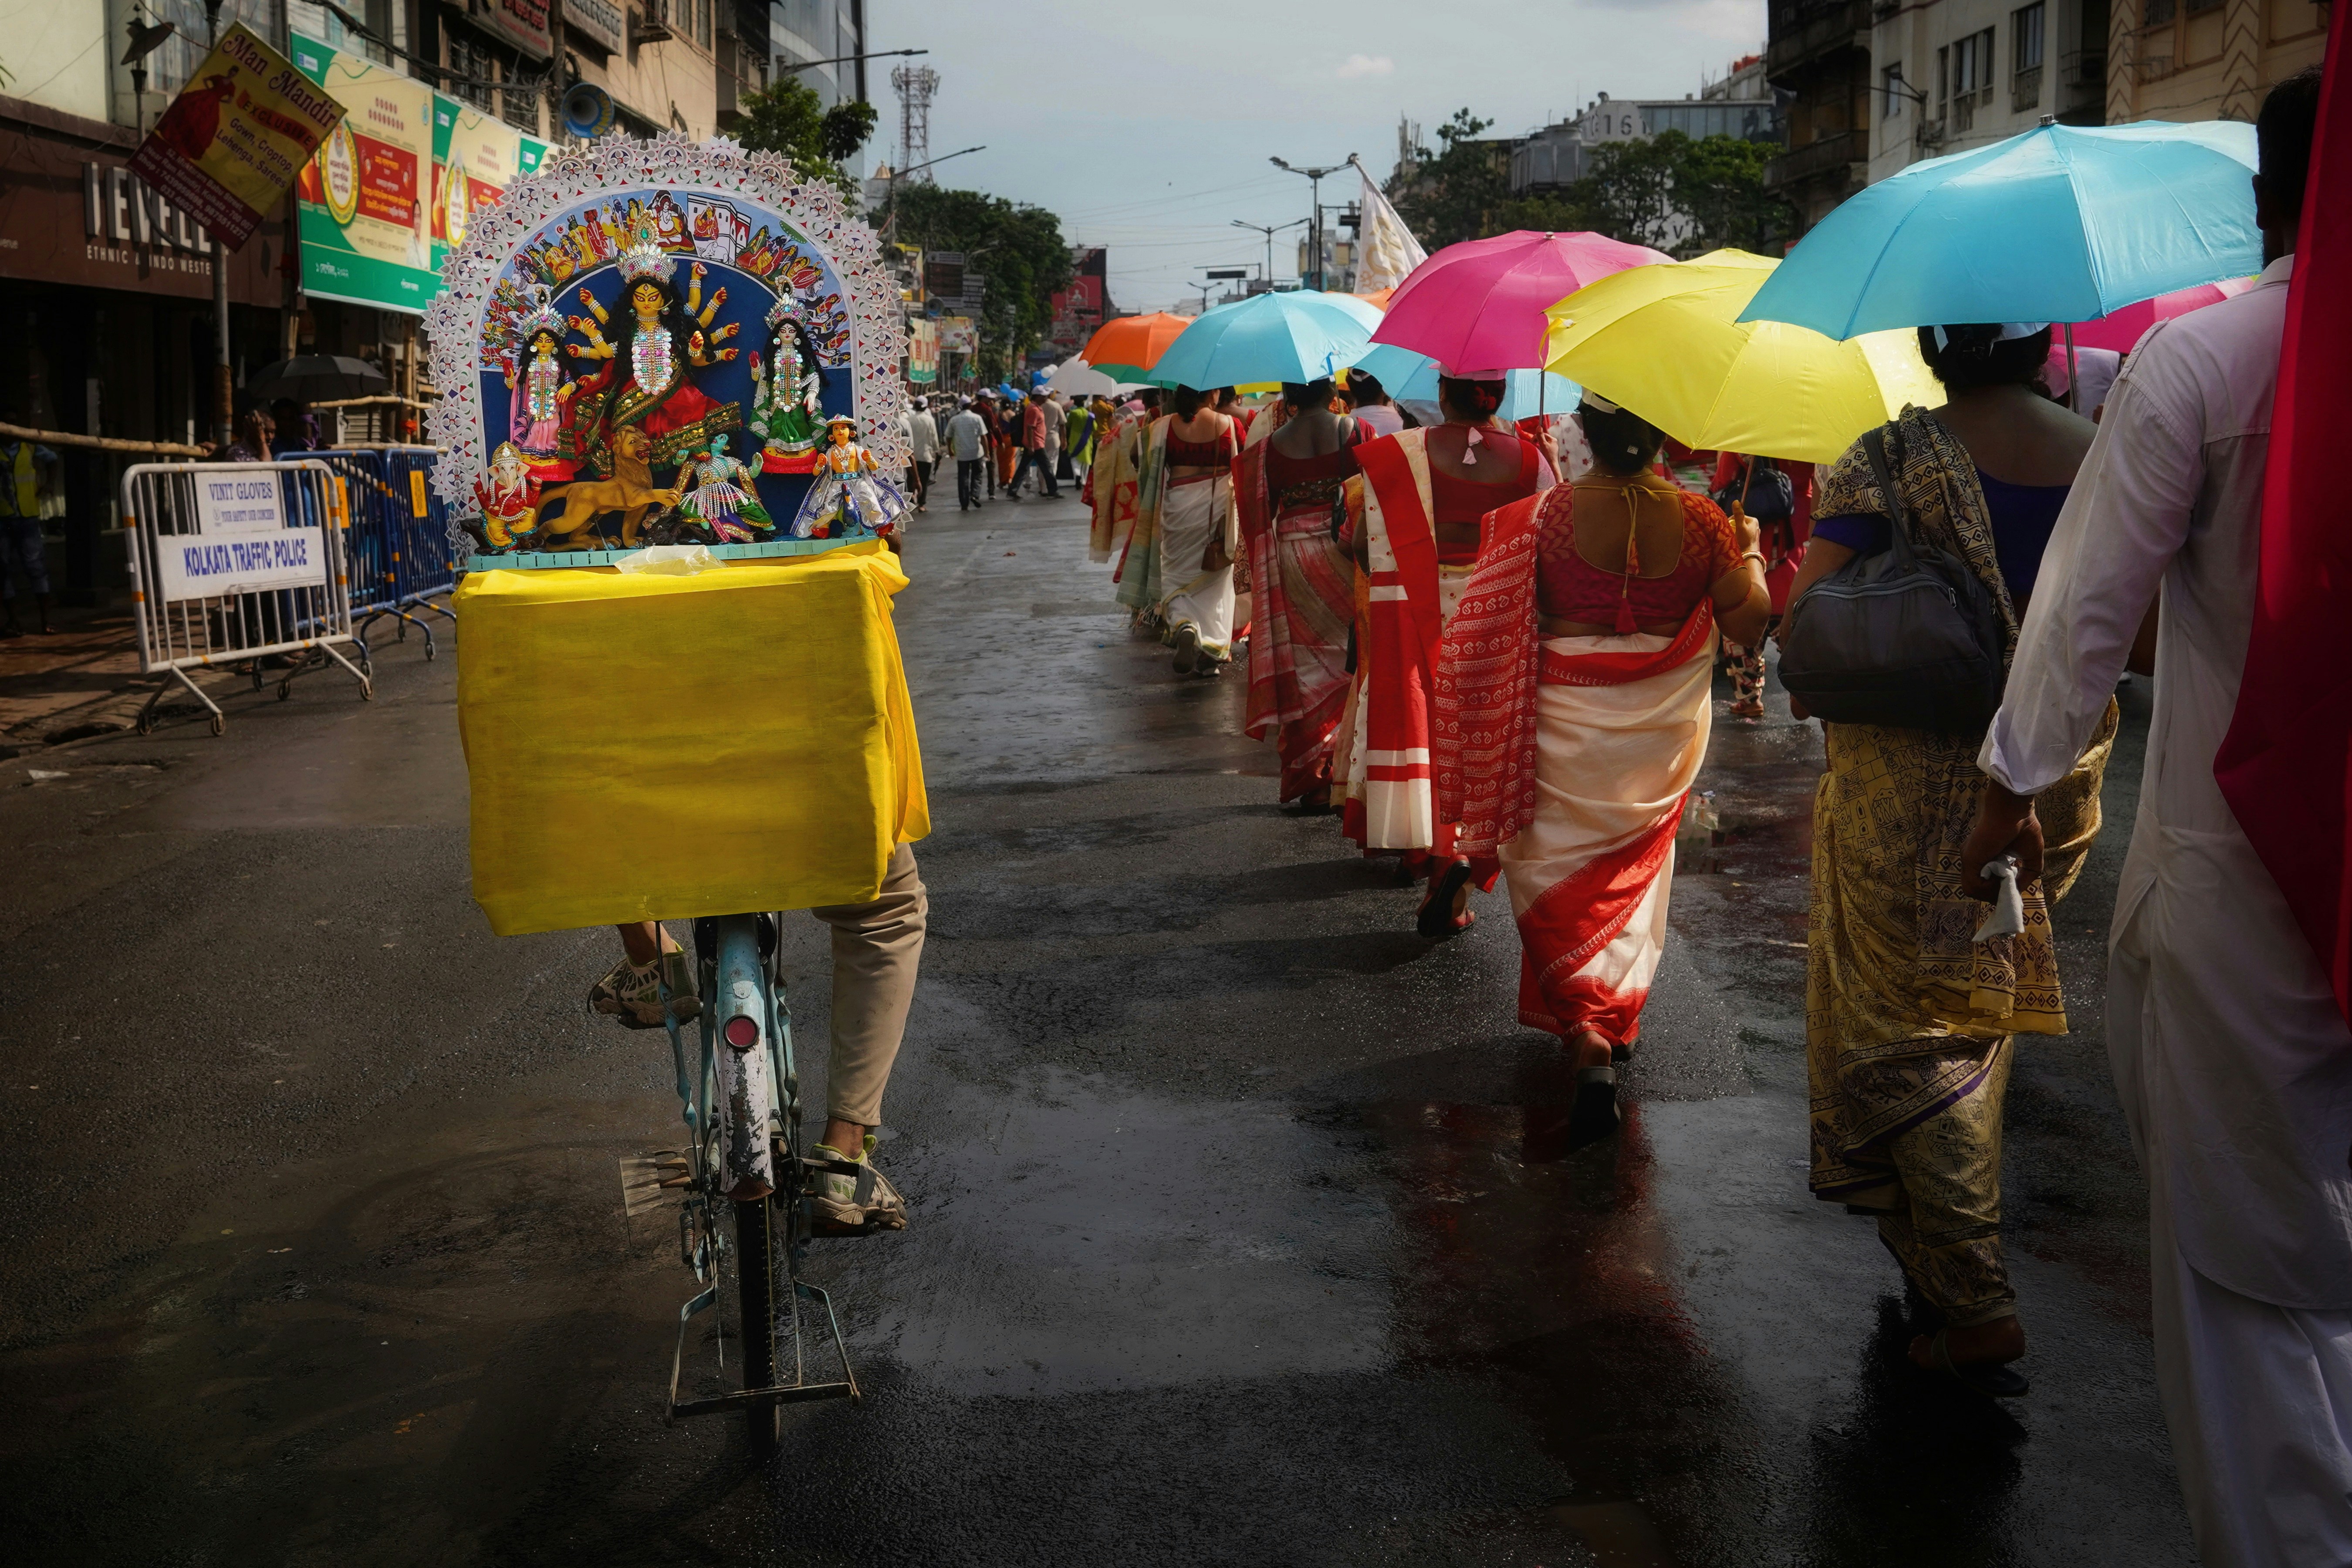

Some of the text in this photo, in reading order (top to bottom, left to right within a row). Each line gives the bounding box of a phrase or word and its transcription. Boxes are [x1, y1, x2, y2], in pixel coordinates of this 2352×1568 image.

[221, 34, 337, 128] Man Mandir
[242, 100, 314, 146] EXCLUSIVE
[137, 153, 156, 171] Shop
[216, 129, 287, 188] Lehenga, Sarees
[230, 118, 292, 174] Gown, Croptop,
[202, 189, 226, 211] Kolkata
[87, 245, 128, 264] ETHNIC
[149, 254, 175, 270] INDO
[180, 258, 211, 276] WESTE
[209, 482, 272, 500] VINIT GLOVES
[184, 538, 307, 577] KOLKATA TRAFFIC POLICE
